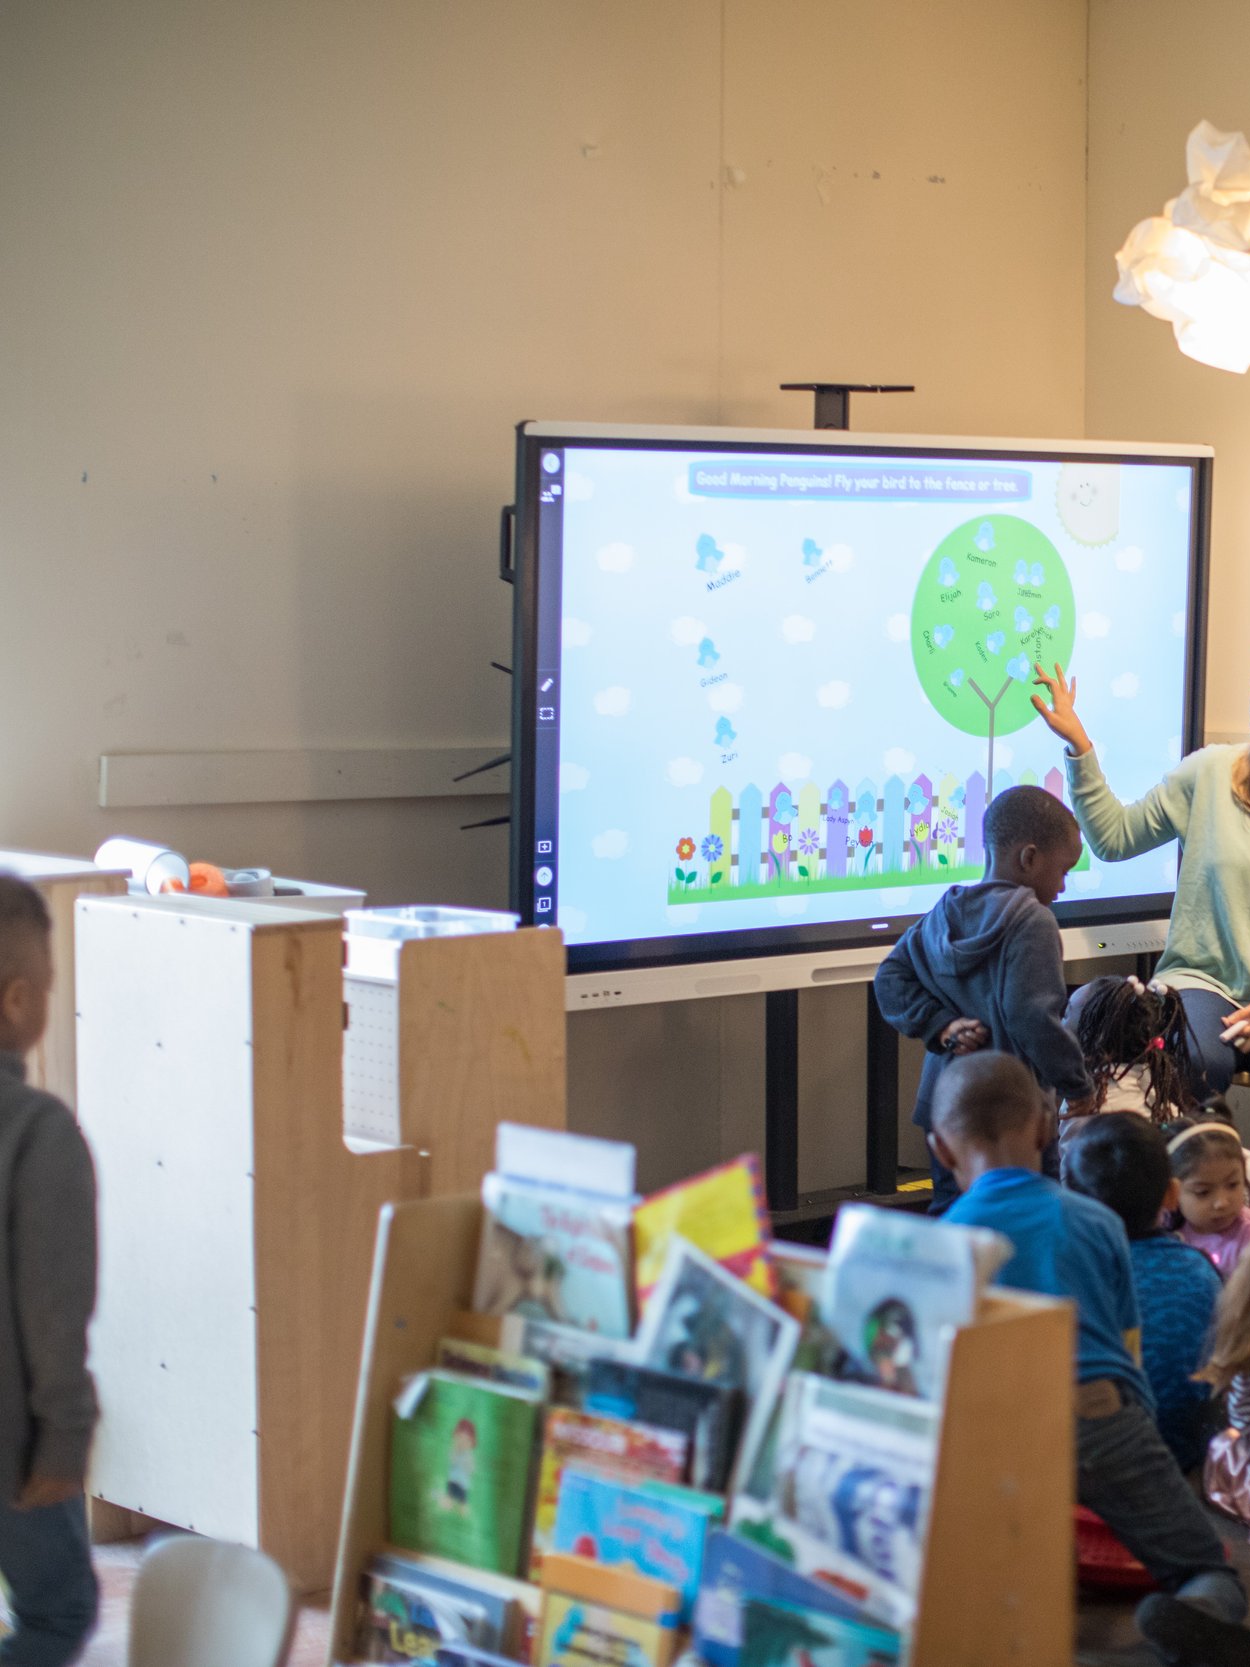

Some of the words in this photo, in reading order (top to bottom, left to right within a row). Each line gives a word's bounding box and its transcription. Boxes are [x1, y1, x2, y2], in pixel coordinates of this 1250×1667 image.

[697, 471, 727, 486] Good
[730, 472, 777, 491] Morning
[780, 472, 832, 491] Penguins!
[834, 474, 852, 492] Fly
[854, 478, 878, 491] your
[882, 475, 907, 490] bird
[909, 476, 921, 490] to
[923, 476, 943, 490] the
[945, 476, 976, 491] fence
[978, 480, 990, 491] or
[993, 477, 1018, 492] tree.
[967, 553, 997, 567] Kameron
[706, 570, 741, 592] Maddie
[940, 589, 962, 604] Elijah
[700, 672, 728, 687] Gideon
[720, 753, 738, 764] Zuri
[910, 822, 930, 837] Lydia
